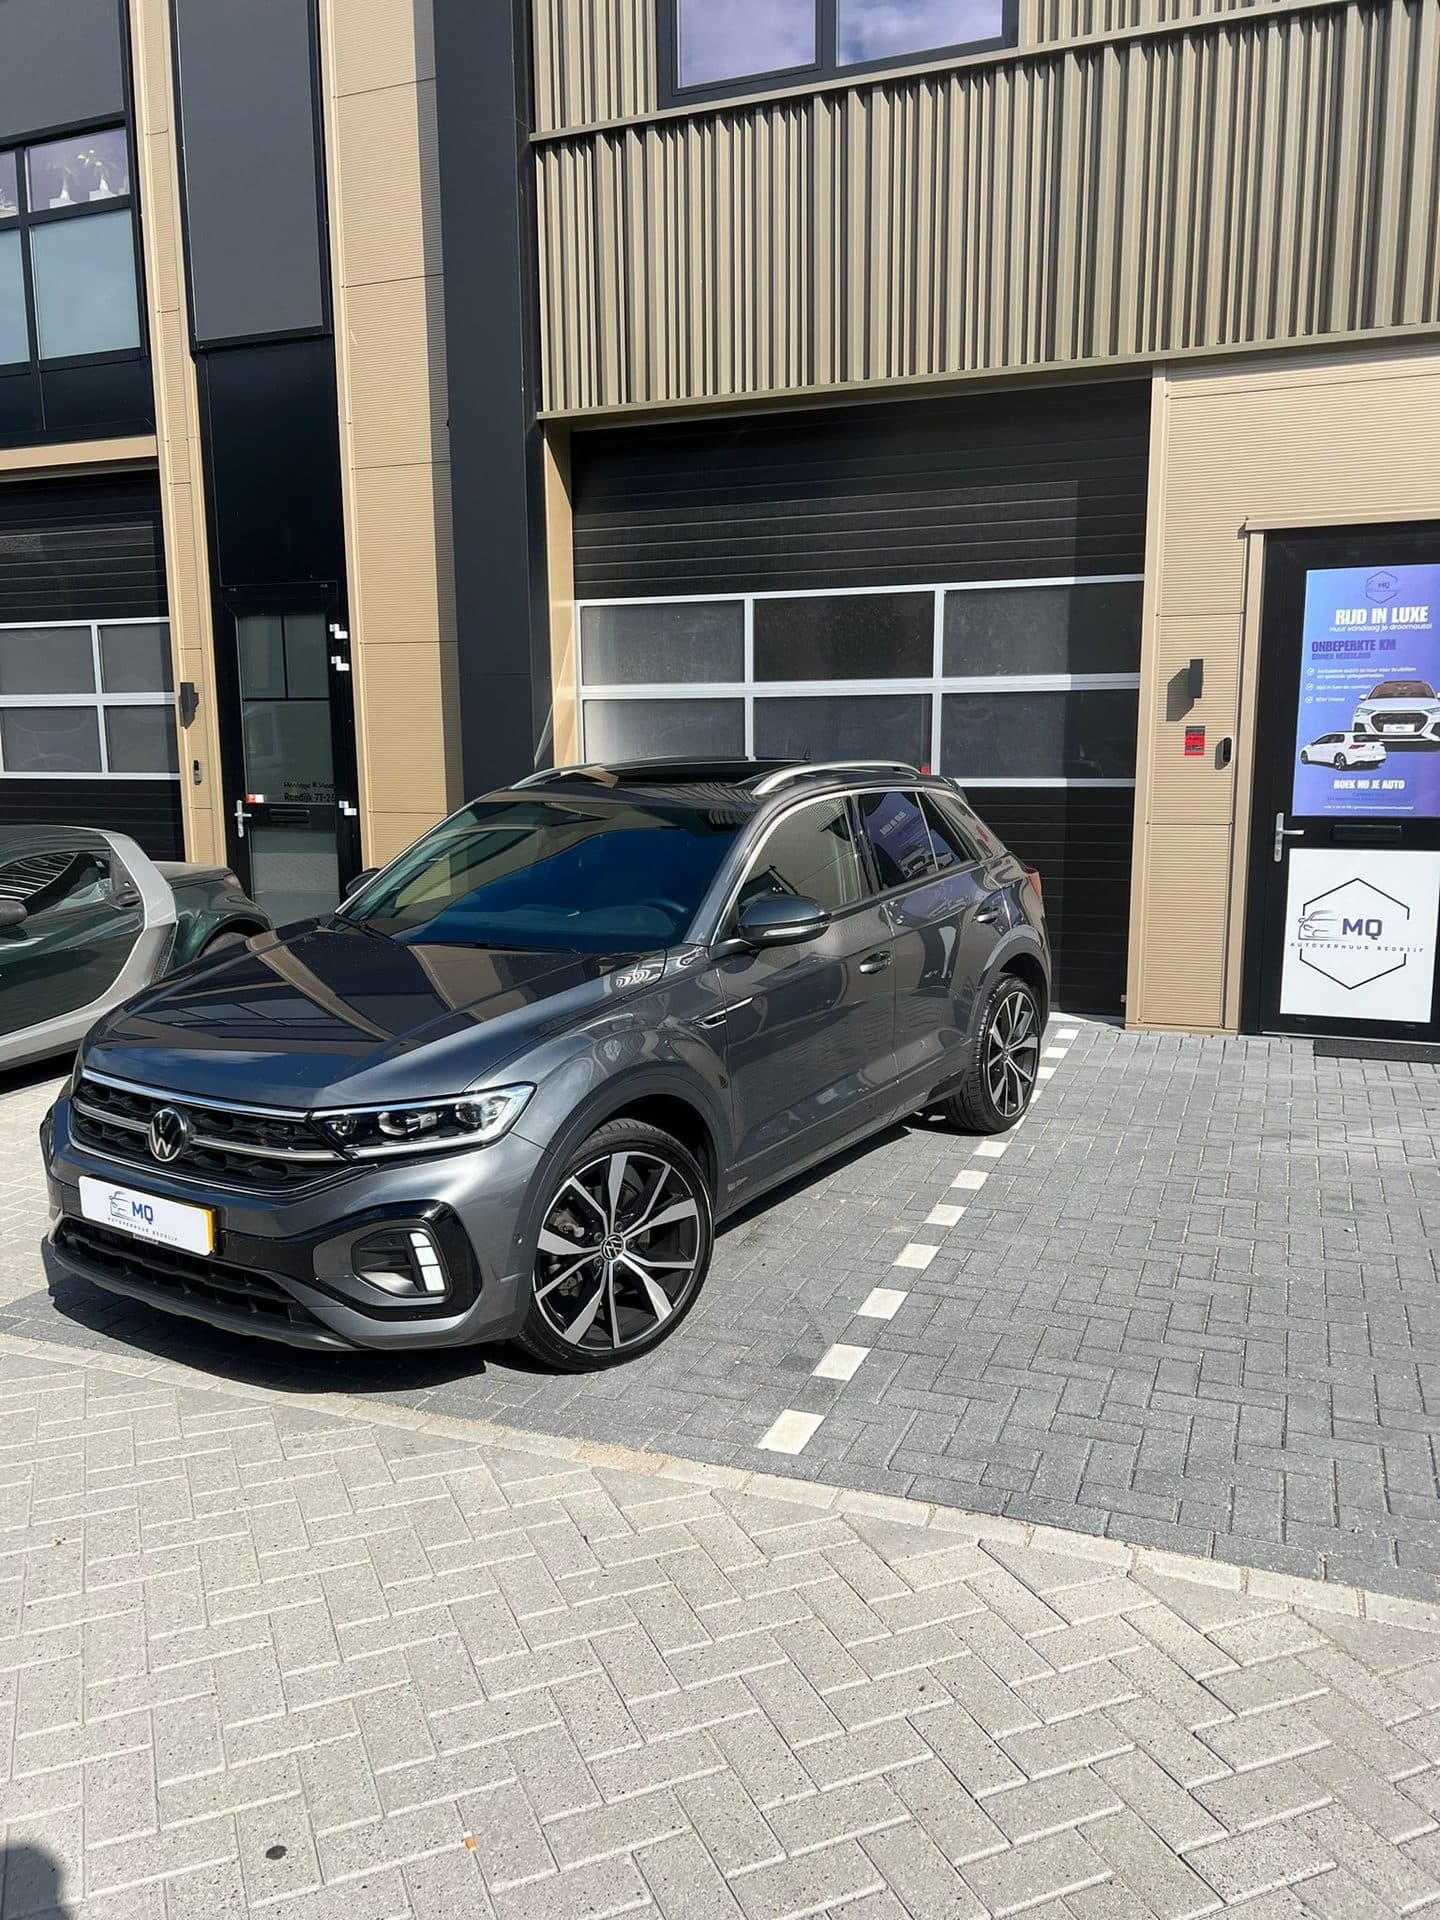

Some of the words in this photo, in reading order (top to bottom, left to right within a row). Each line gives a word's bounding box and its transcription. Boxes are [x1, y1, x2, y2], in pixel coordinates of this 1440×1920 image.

[1335, 608, 1367, 625] RIJD
[1371, 607, 1388, 624] IN
[1391, 605, 1429, 623] LUXE
[1329, 625, 1346, 633] Huur
[1347, 624, 1380, 633] vandaag
[1380, 623, 1388, 632] je
[1389, 622, 1433, 631] droomauto!
[1311, 639, 1376, 653] ONBEPERKTE
[1379, 638, 1397, 651] KM
[1333, 780, 1355, 790] BOEK
[1357, 780, 1369, 789] NU
[1371, 780, 1381, 789] JE
[1382, 780, 1405, 790] AUTO
[1342, 918, 1383, 940] MQ
[1289, 942, 1369, 950] AUTOVERHUUR
[131, 1201, 154, 1225] MQ
